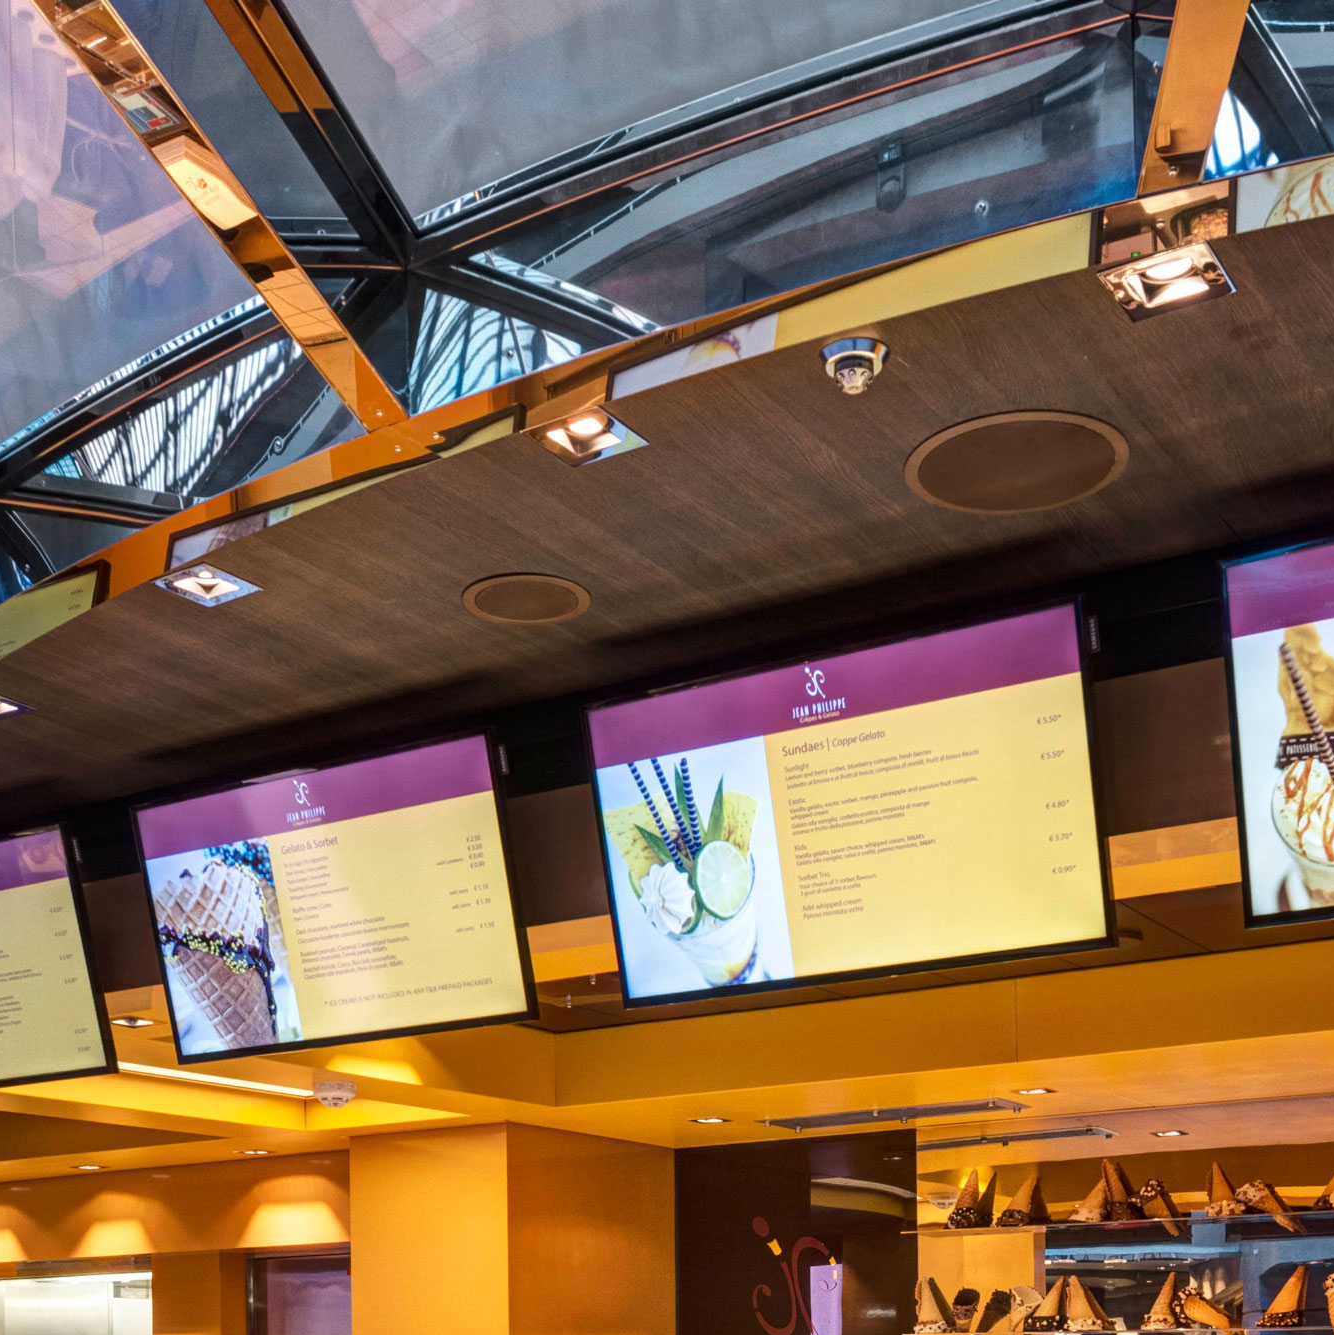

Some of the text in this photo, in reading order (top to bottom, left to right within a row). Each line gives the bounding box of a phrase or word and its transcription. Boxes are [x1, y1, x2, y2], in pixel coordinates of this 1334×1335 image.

[792, 697, 846, 719] JEAN PHILIPPE
[781, 738, 824, 757] Sundaes
[831, 733, 858, 749] Coppe
[857, 728, 885, 742] Gelato
[280, 841, 306, 855] Gelato
[312, 835, 338, 849] Sorbet
